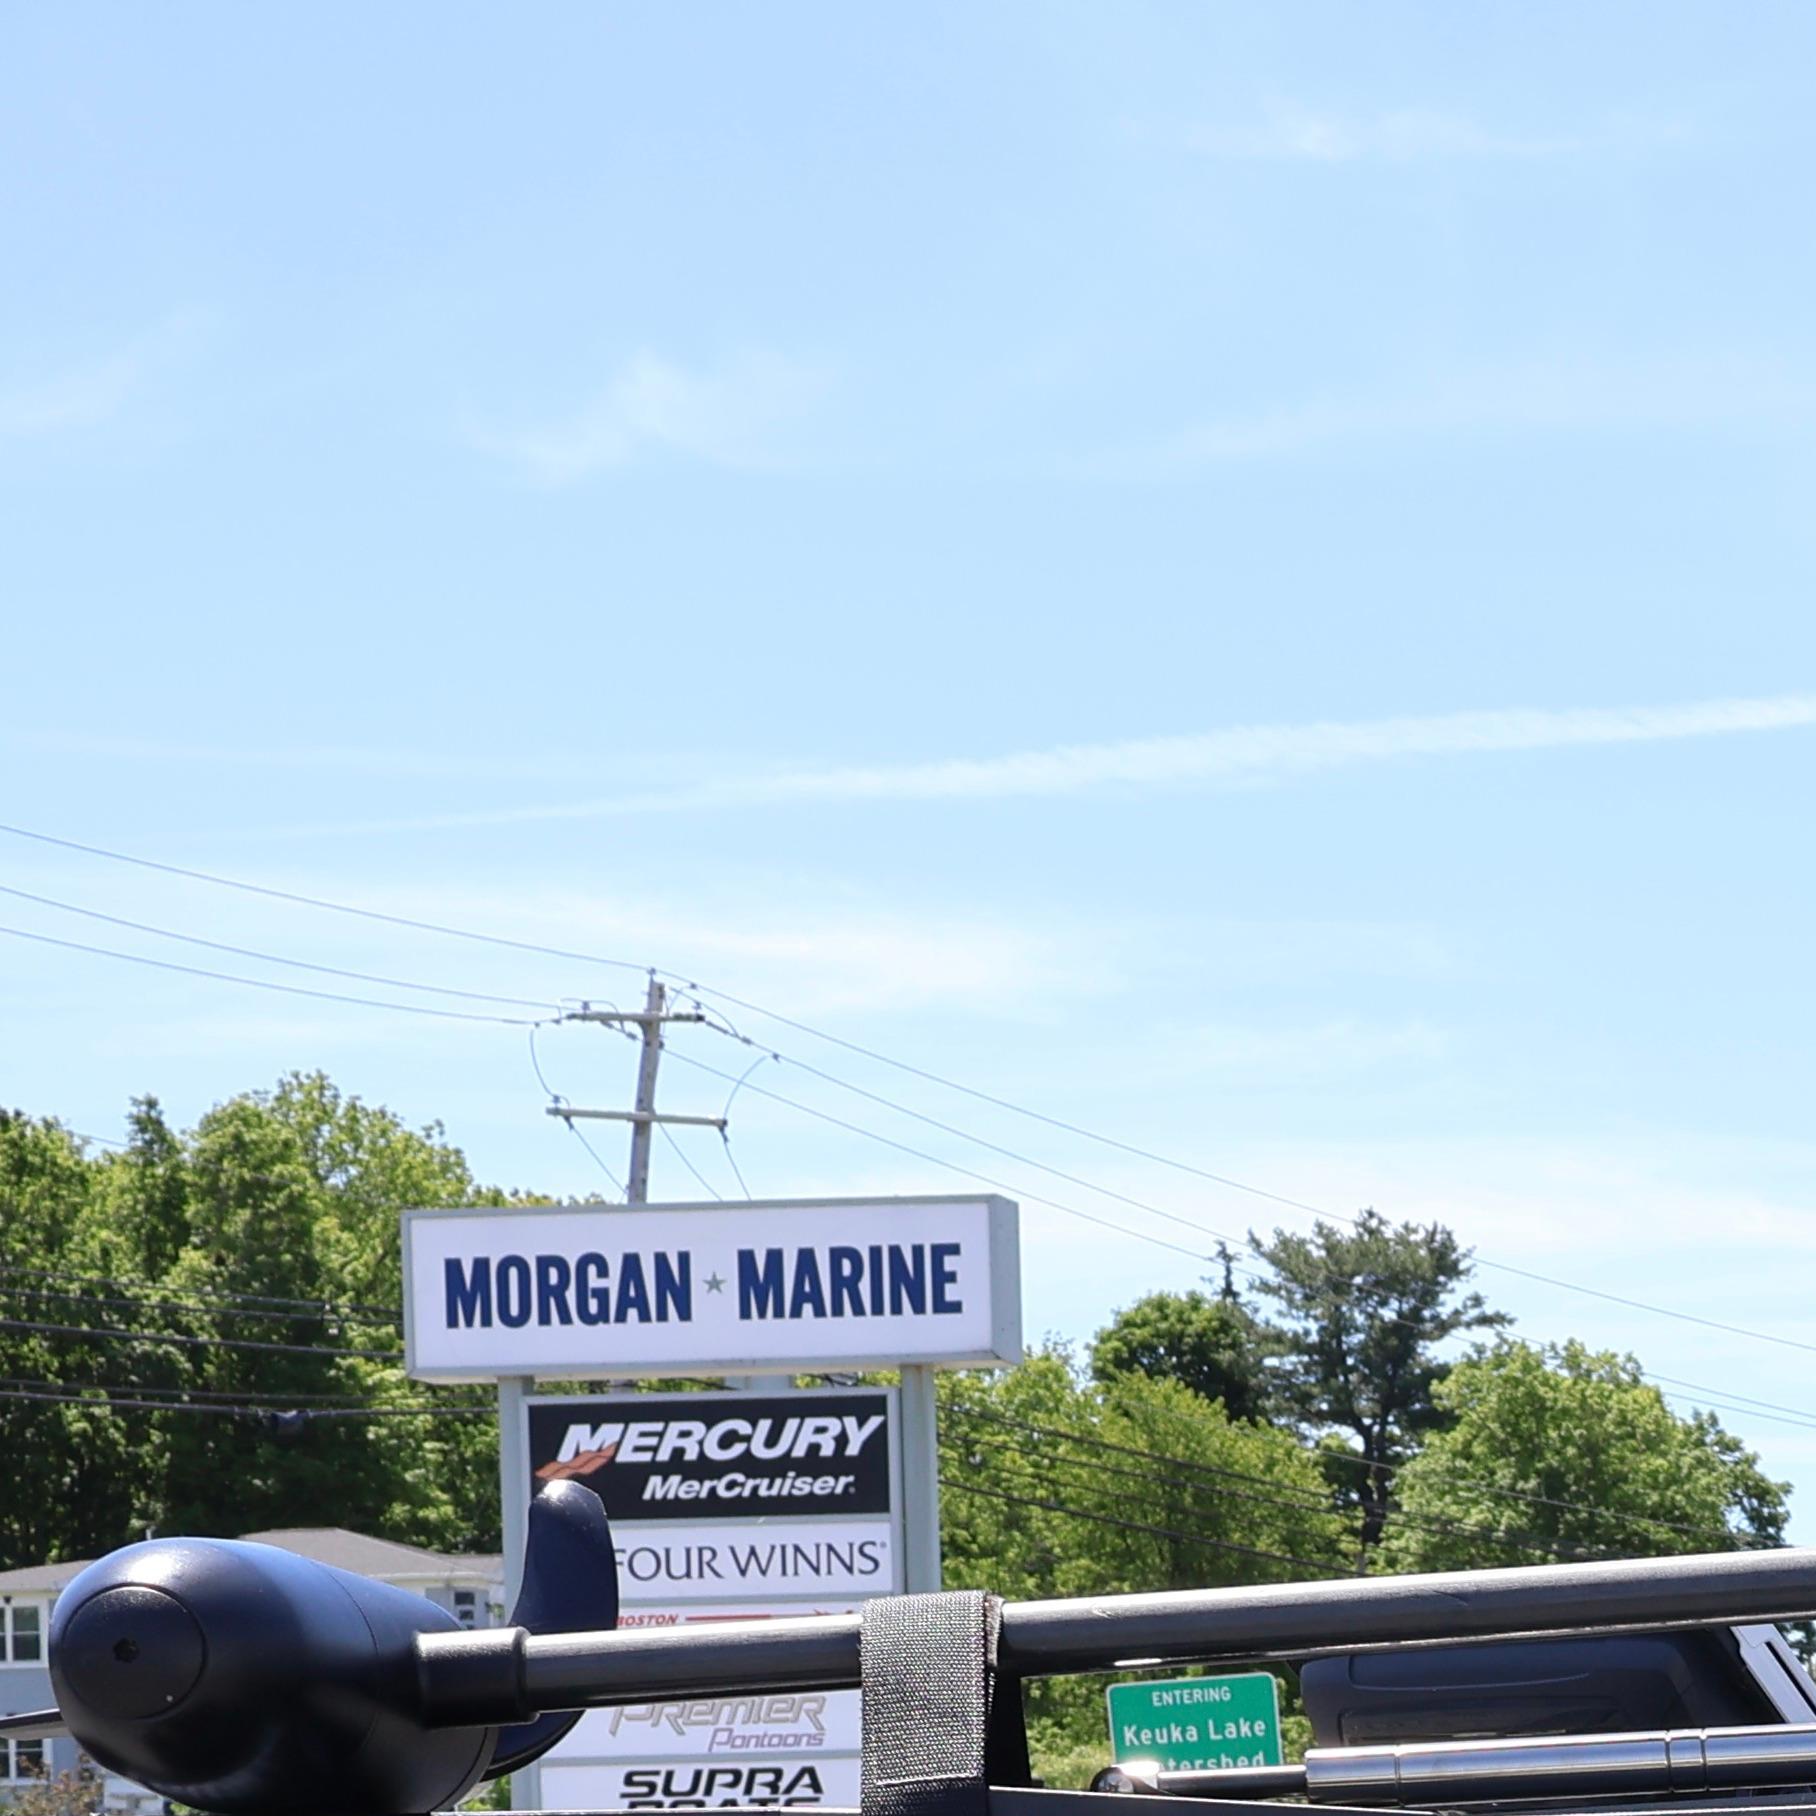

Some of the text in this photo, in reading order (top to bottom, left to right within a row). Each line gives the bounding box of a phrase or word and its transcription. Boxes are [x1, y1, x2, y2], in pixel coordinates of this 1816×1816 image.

[443, 1242, 964, 1329] MORGAN MARINE
[556, 1414, 887, 1464] MERCURY
[642, 1471, 851, 1502] MerCruiser
[728, 1540, 881, 1578] WINNS
[1151, 1686, 1232, 1707] ENTERING
[708, 1728, 826, 1752] Pontoons
[1123, 1716, 1266, 1746] Keuka Lake
[618, 1766, 825, 1799] SUPRA
